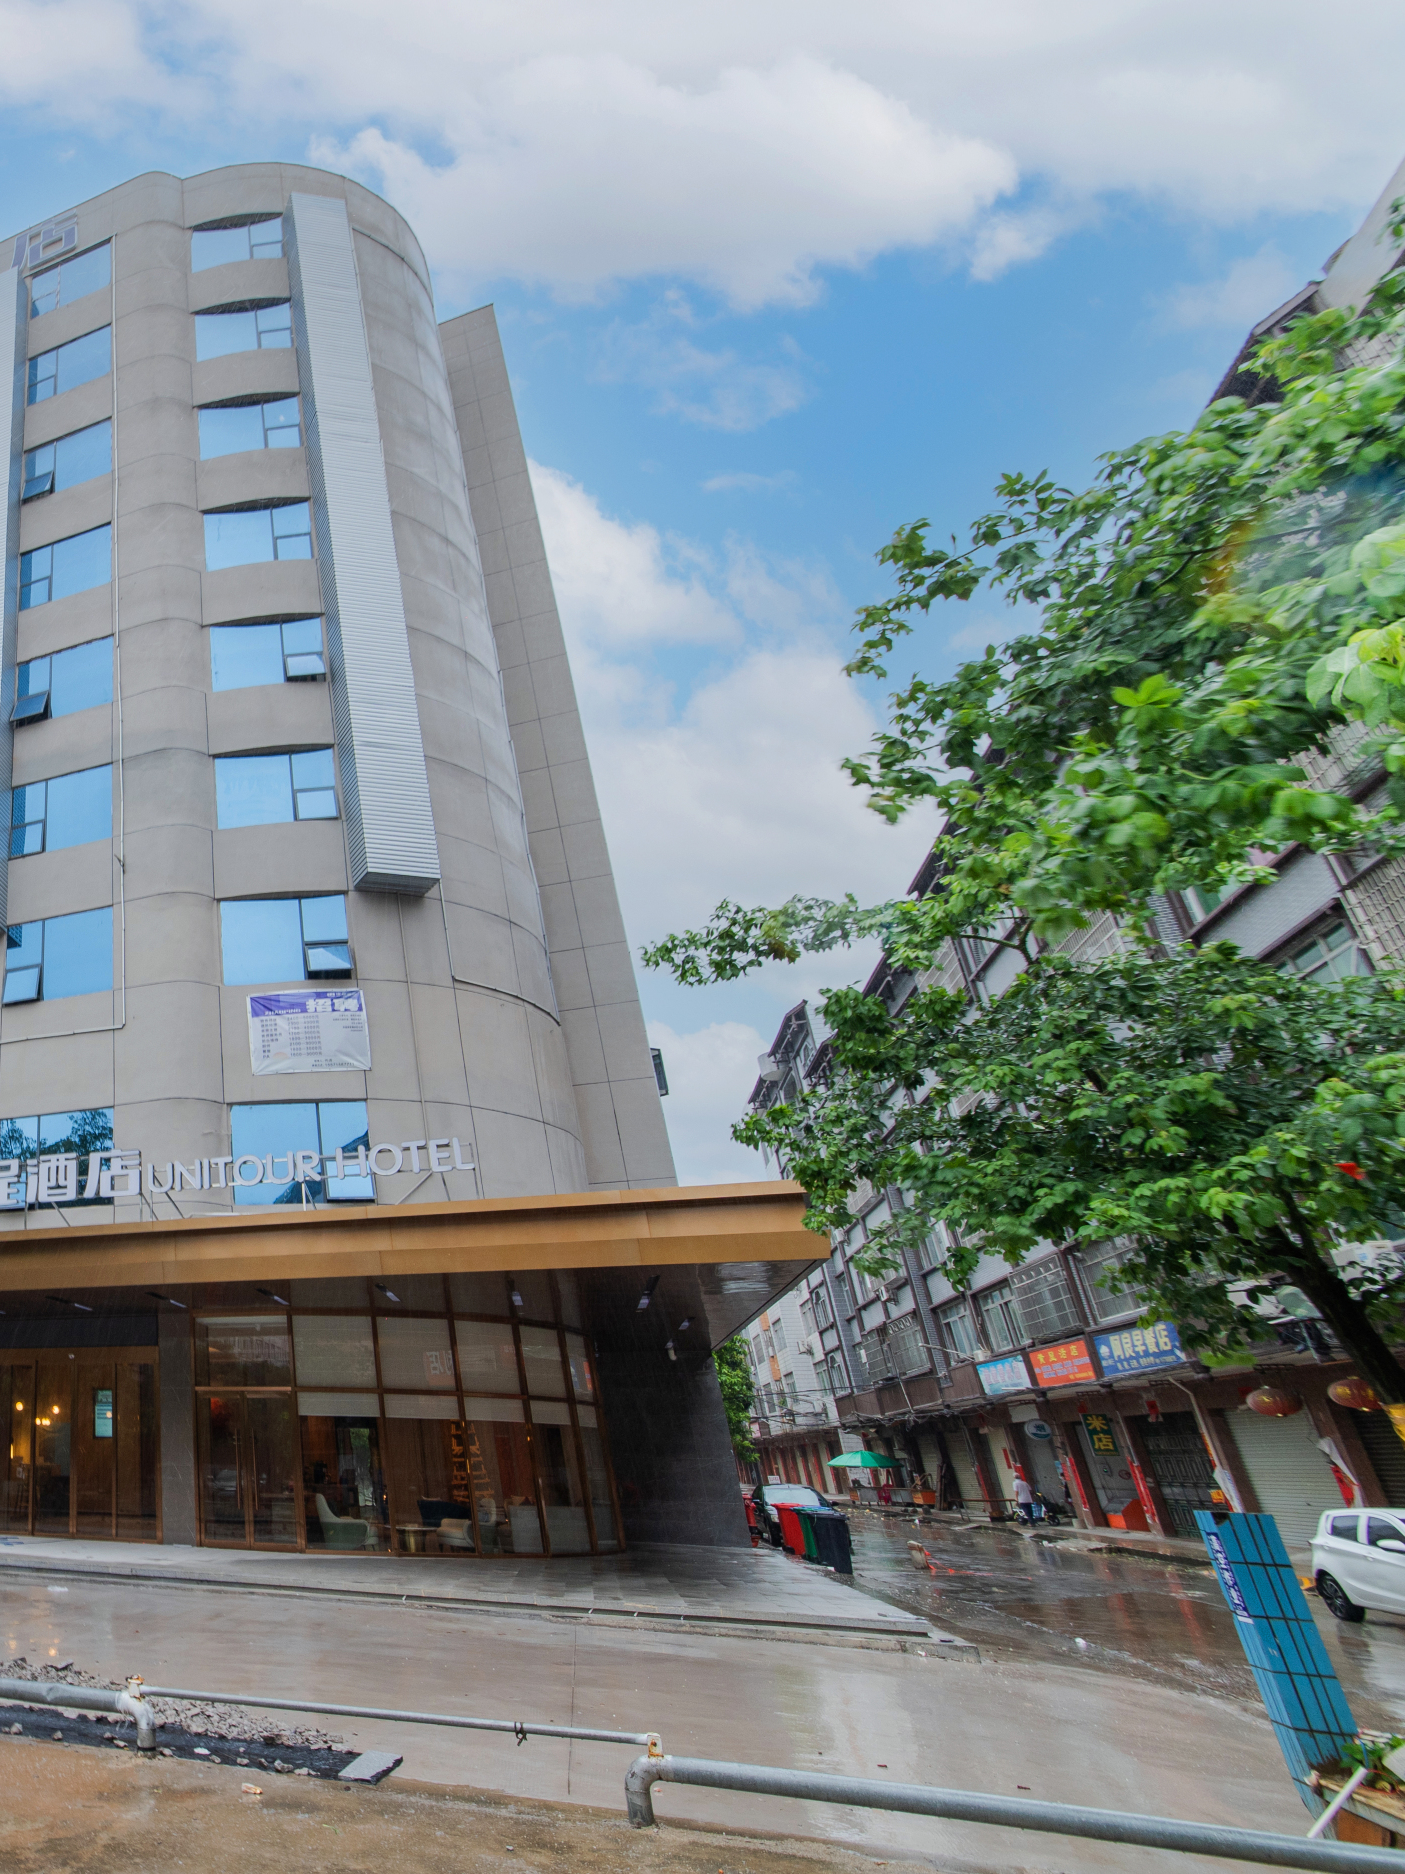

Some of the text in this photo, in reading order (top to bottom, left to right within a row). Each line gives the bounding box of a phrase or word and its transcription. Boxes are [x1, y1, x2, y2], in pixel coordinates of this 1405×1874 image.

[147, 1137, 476, 1194] UNITOUR HOTEL
[1086, 1414, 1114, 1450] 米店
